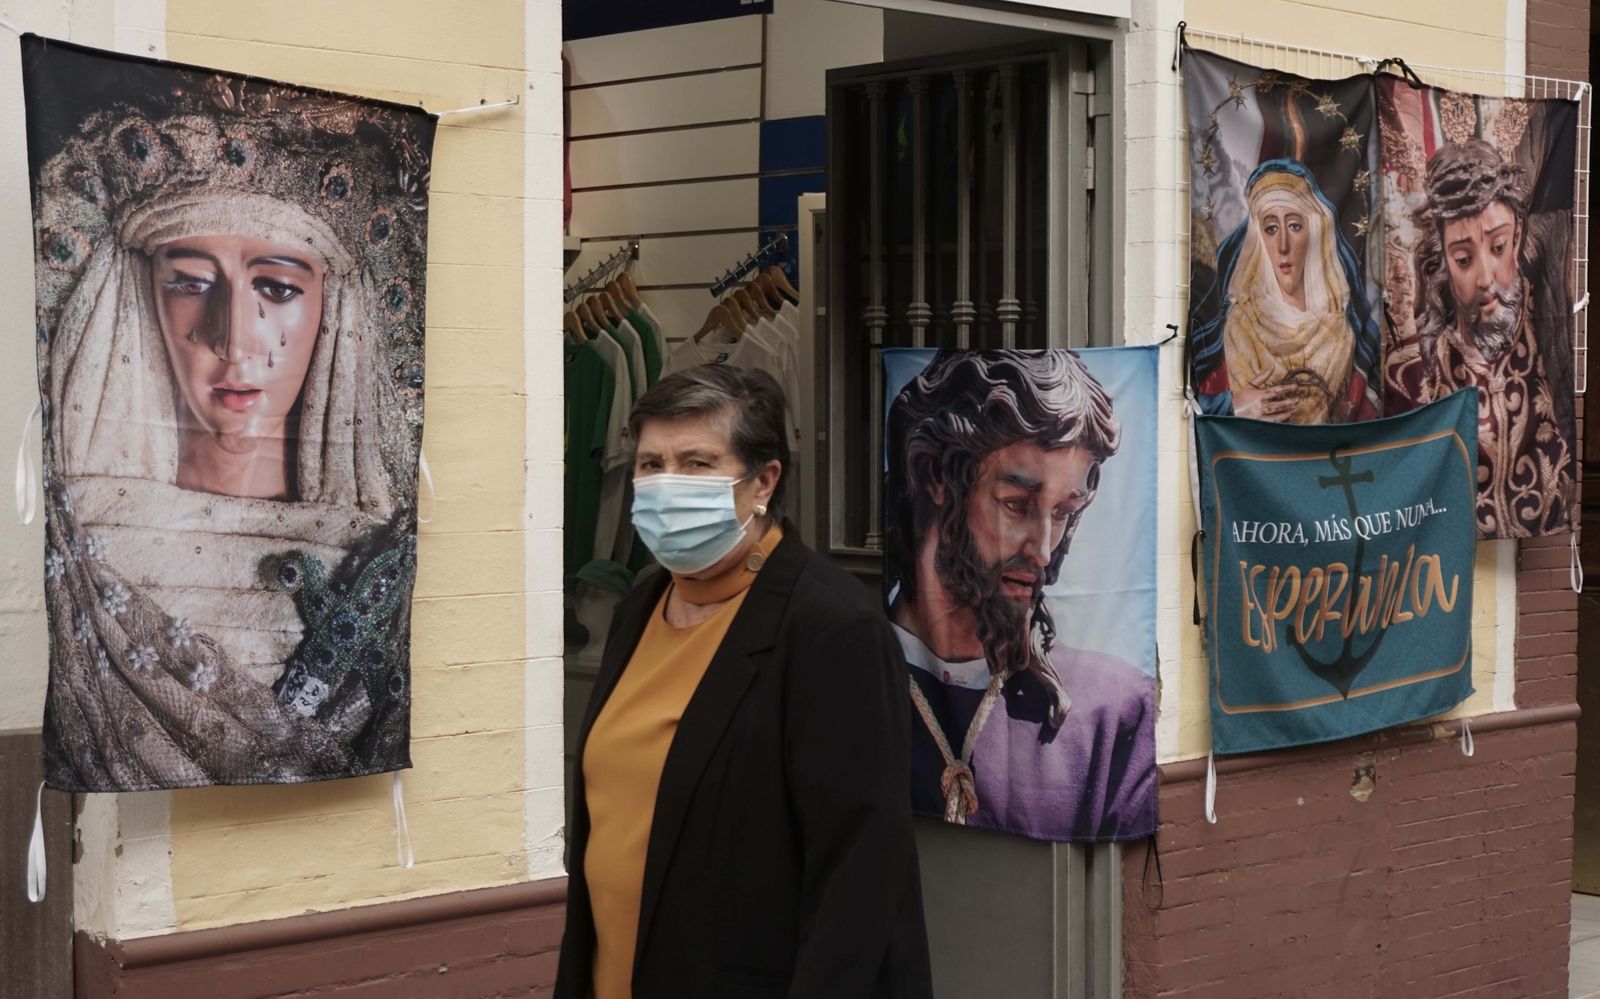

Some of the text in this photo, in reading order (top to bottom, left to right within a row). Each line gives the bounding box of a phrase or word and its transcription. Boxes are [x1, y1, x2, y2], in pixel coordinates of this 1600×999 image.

[1232, 497, 1447, 547] AHORA, MÁS QUE NUNA...
